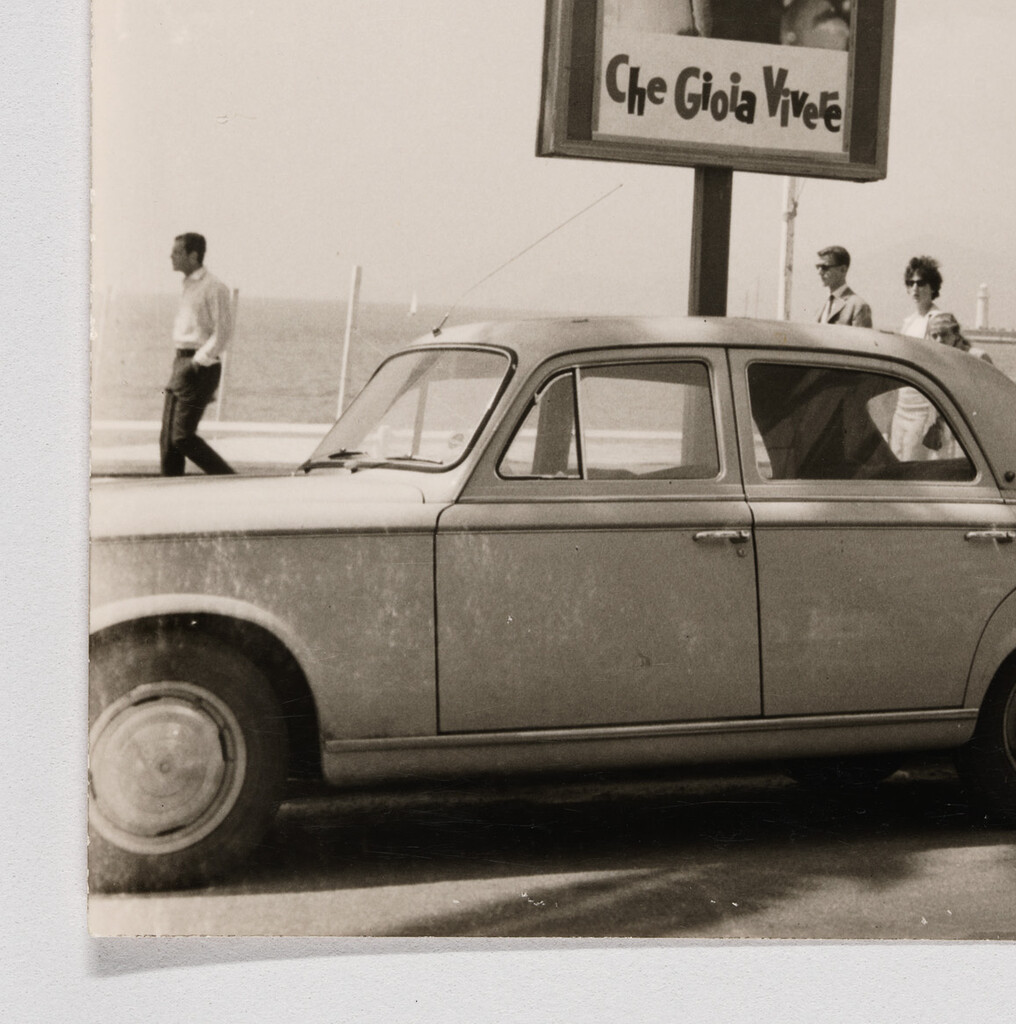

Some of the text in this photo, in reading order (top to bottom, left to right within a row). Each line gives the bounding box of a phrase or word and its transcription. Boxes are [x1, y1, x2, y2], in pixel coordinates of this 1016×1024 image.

[605, 54, 842, 133] Che Gioia Vivere
